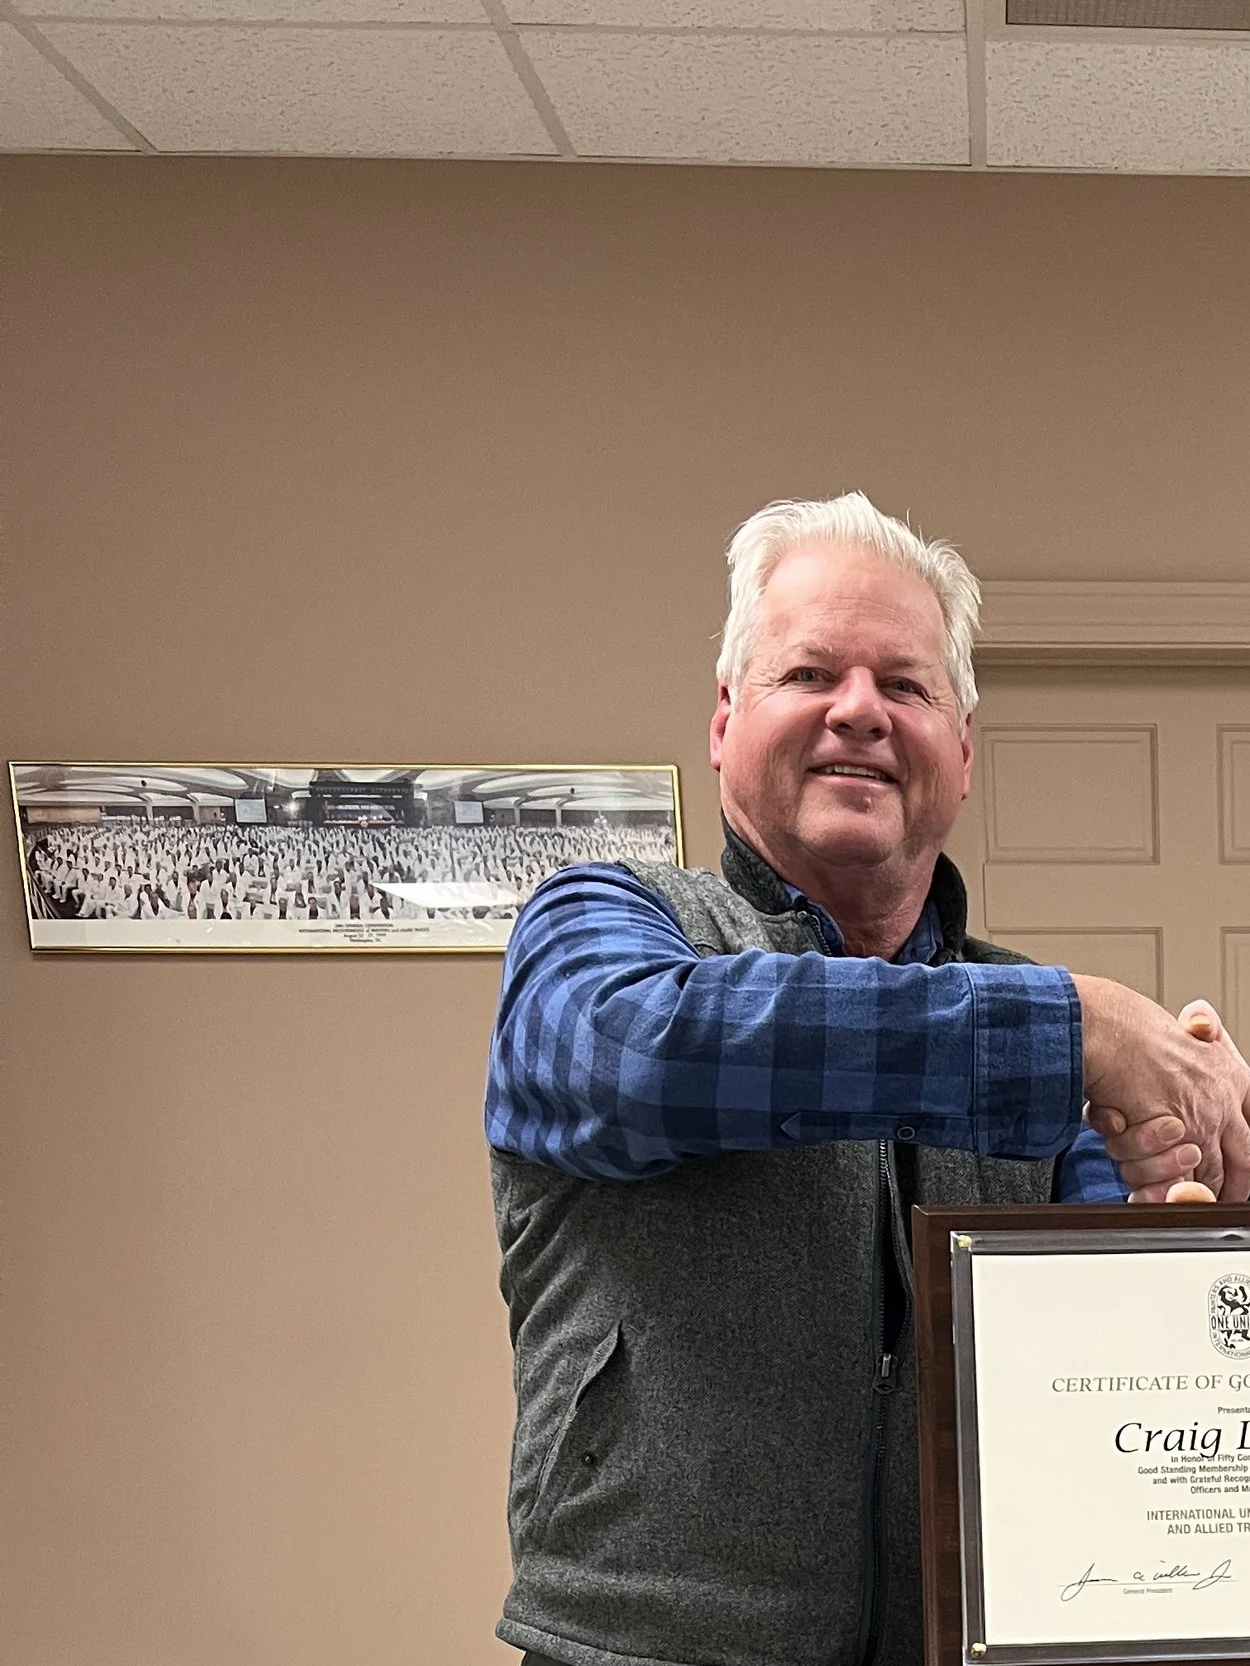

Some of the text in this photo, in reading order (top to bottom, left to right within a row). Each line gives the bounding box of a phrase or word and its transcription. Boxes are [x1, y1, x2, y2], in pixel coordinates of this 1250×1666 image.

[1211, 1315, 1229, 1330] ONE
[1051, 1375, 1189, 1393] CERTIFICATE
[1195, 1374, 1223, 1391] OF
[1114, 1421, 1223, 1458] Craig
[1181, 1455, 1204, 1463] Honor
[1218, 1454, 1235, 1463] Fifty
[1138, 1466, 1158, 1475] Good
[1160, 1465, 1196, 1475] Standing
[1199, 1464, 1249, 1474] Membership
[1152, 1476, 1168, 1484] and
[1170, 1475, 1188, 1484] with
[1190, 1475, 1222, 1484] Grateful
[1190, 1486, 1221, 1494] Officers
[1224, 1485, 1239, 1493] and
[1147, 1507, 1236, 1520] INTERNATIONAL
[1167, 1523, 1191, 1535] AND
[1194, 1522, 1233, 1533] ALLIED
